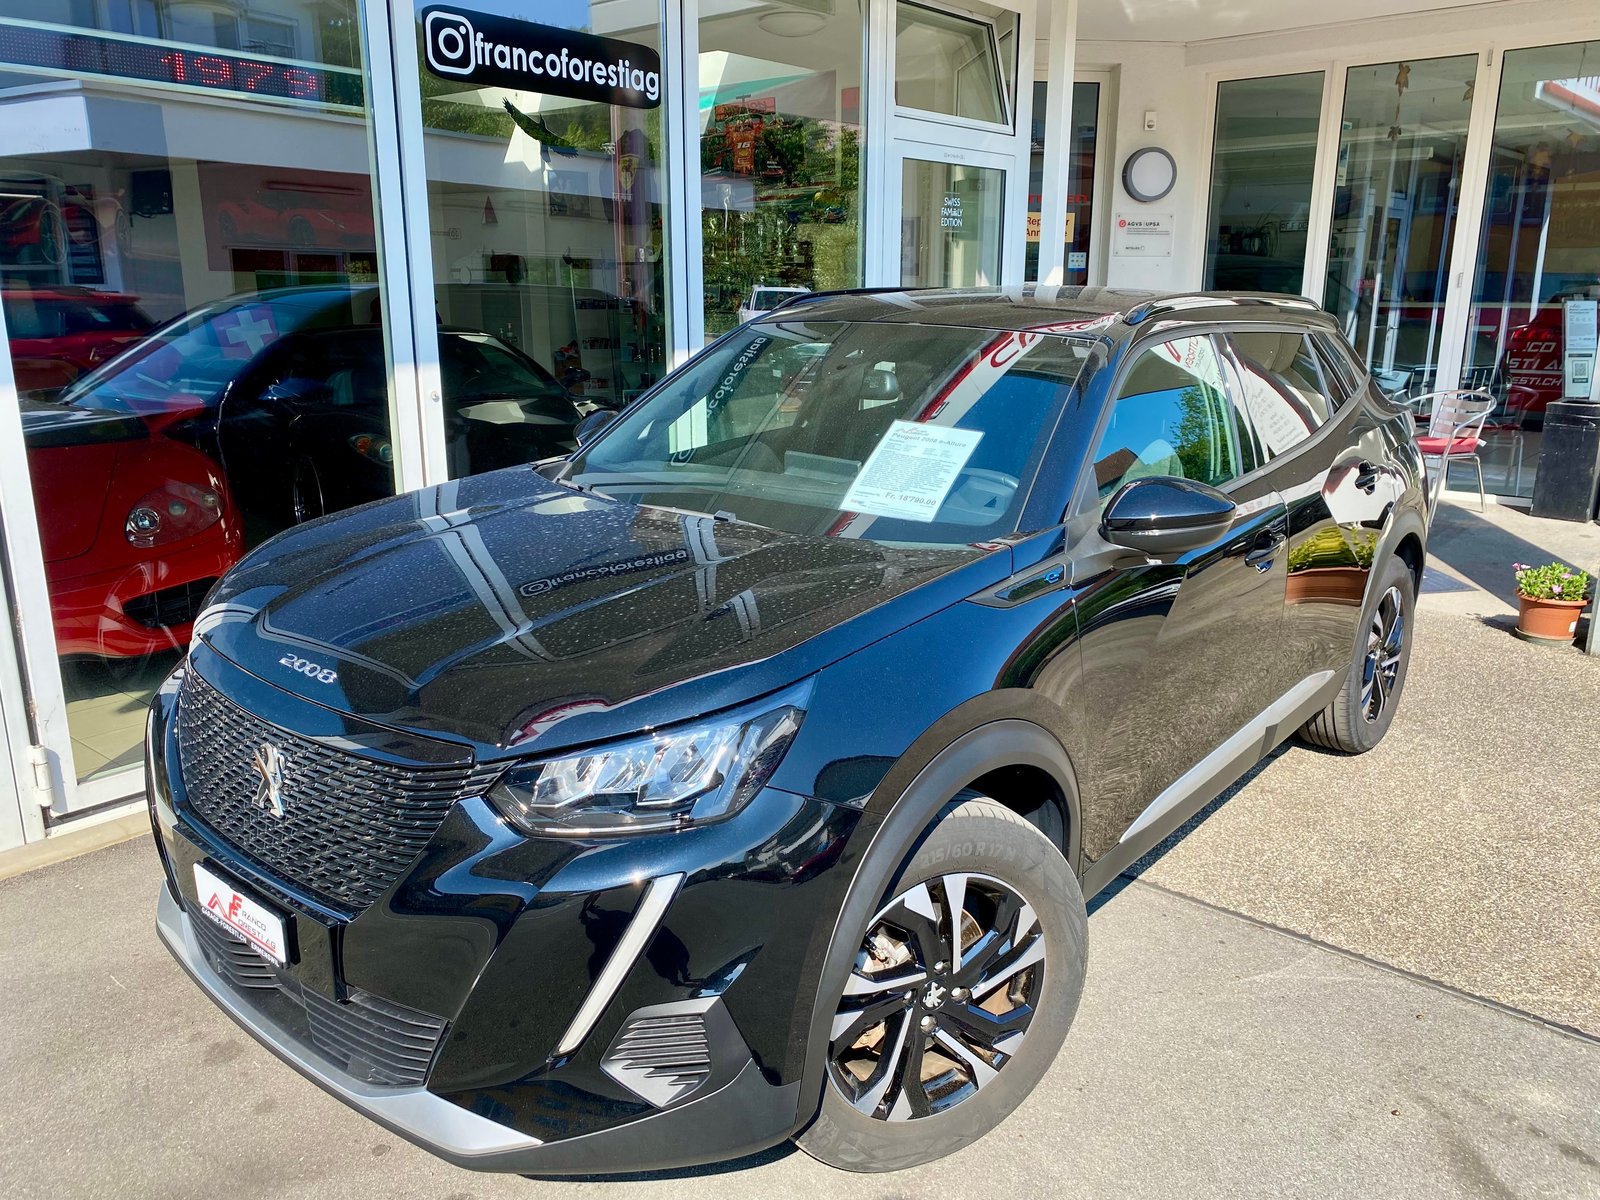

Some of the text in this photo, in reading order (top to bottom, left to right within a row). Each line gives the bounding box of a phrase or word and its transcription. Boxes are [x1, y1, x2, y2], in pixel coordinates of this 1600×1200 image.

[160, 52, 318, 96] 1979
[474, 32, 660, 101] francoforestiag
[943, 196, 961, 207] SWISS
[940, 217, 963, 227] EDITION
[279, 652, 338, 684] 2008
